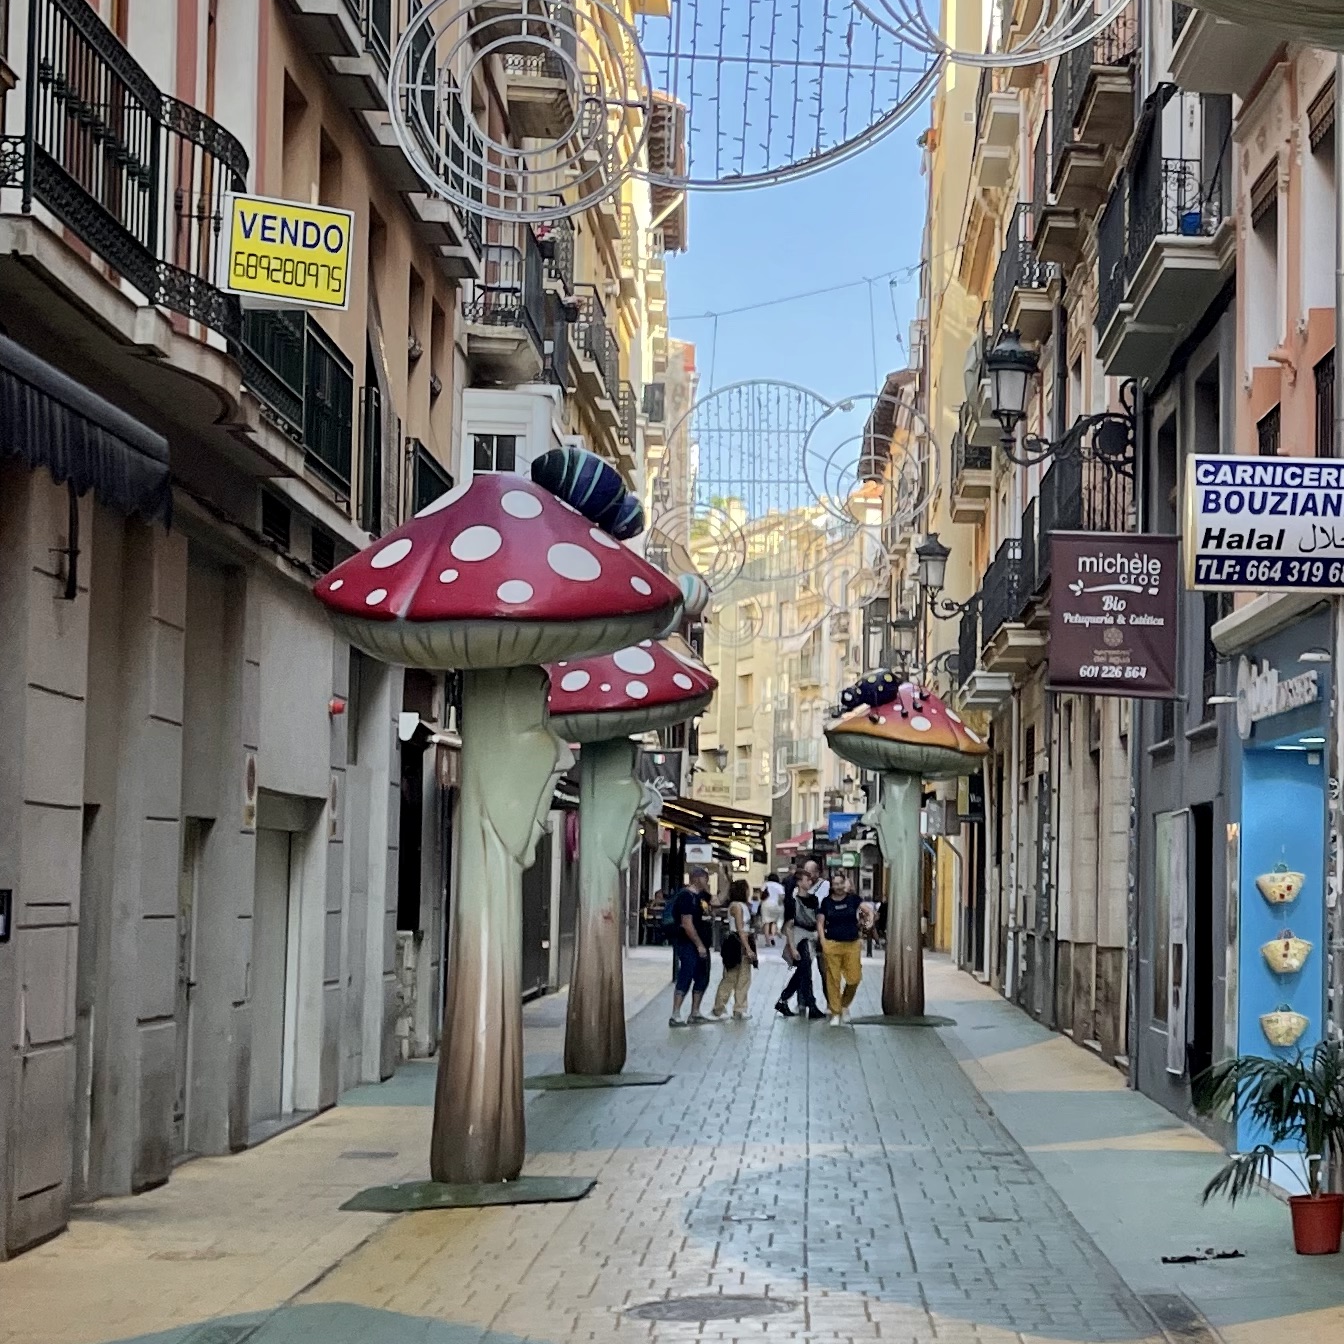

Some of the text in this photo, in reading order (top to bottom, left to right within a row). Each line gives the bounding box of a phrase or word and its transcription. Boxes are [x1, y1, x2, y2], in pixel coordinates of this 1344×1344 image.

[239, 210, 344, 254] VENDO
[233, 251, 342, 293] 689280975
[1201, 527, 1286, 551] Halal
[1077, 552, 1162, 574] michèle
[1198, 559, 1241, 581] TLF:
[1246, 560, 1284, 582] 664
[1287, 561, 1324, 583] 319
[1118, 574, 1161, 586] croc
[1102, 595, 1127, 612] Bio
[1101, 665, 1123, 678] 226
